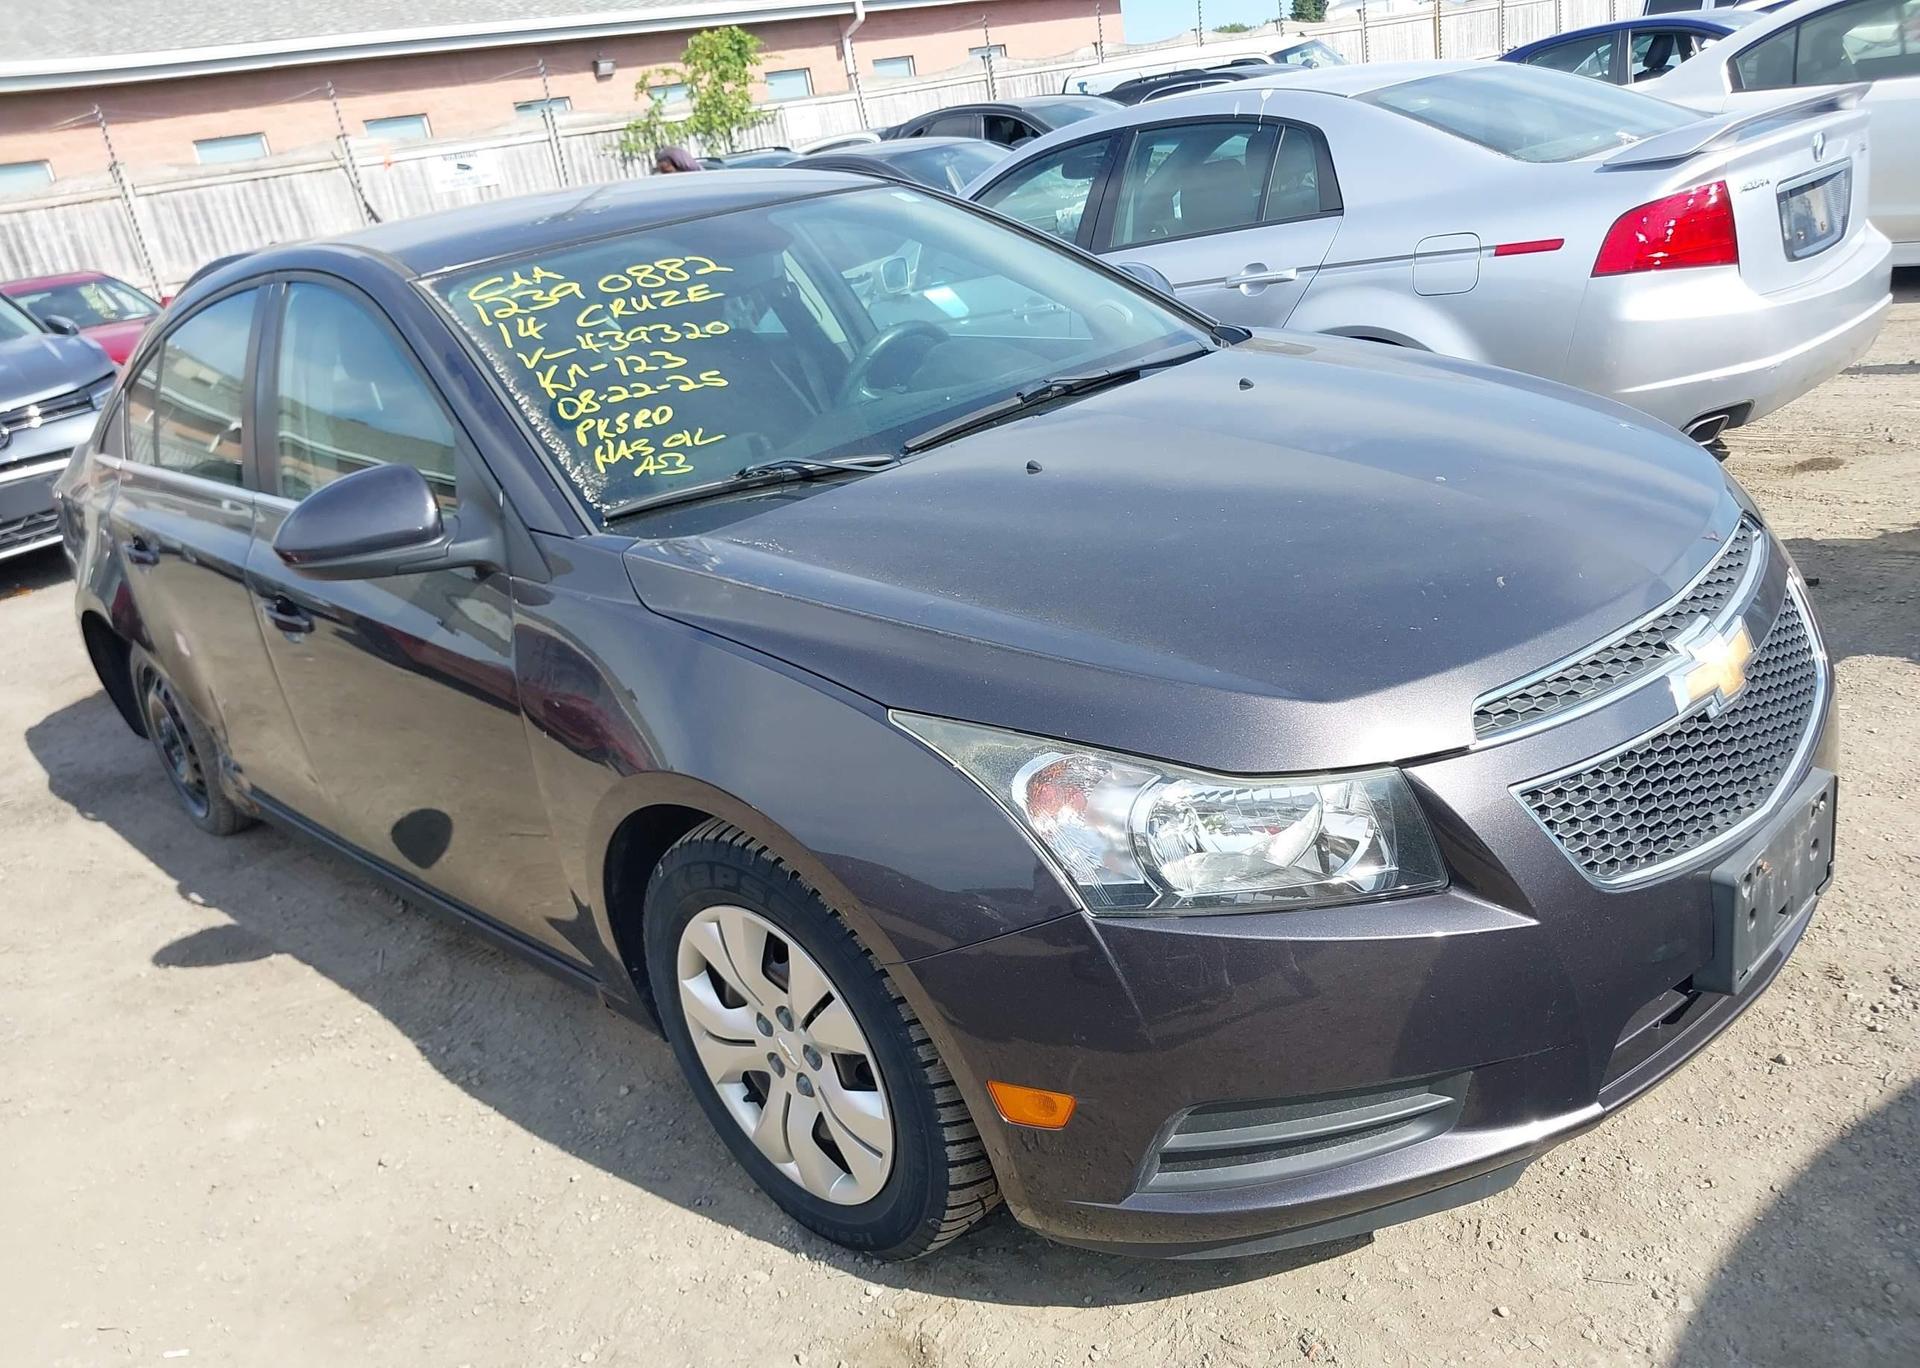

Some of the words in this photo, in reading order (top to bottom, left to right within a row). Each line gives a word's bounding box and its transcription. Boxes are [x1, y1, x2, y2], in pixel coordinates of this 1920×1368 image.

[597, 256, 734, 294] 0882
[498, 316, 548, 349] 14
[576, 283, 725, 328] CRUZE
[557, 370, 730, 421] 08-22-25
[662, 427, 728, 448] OIL
